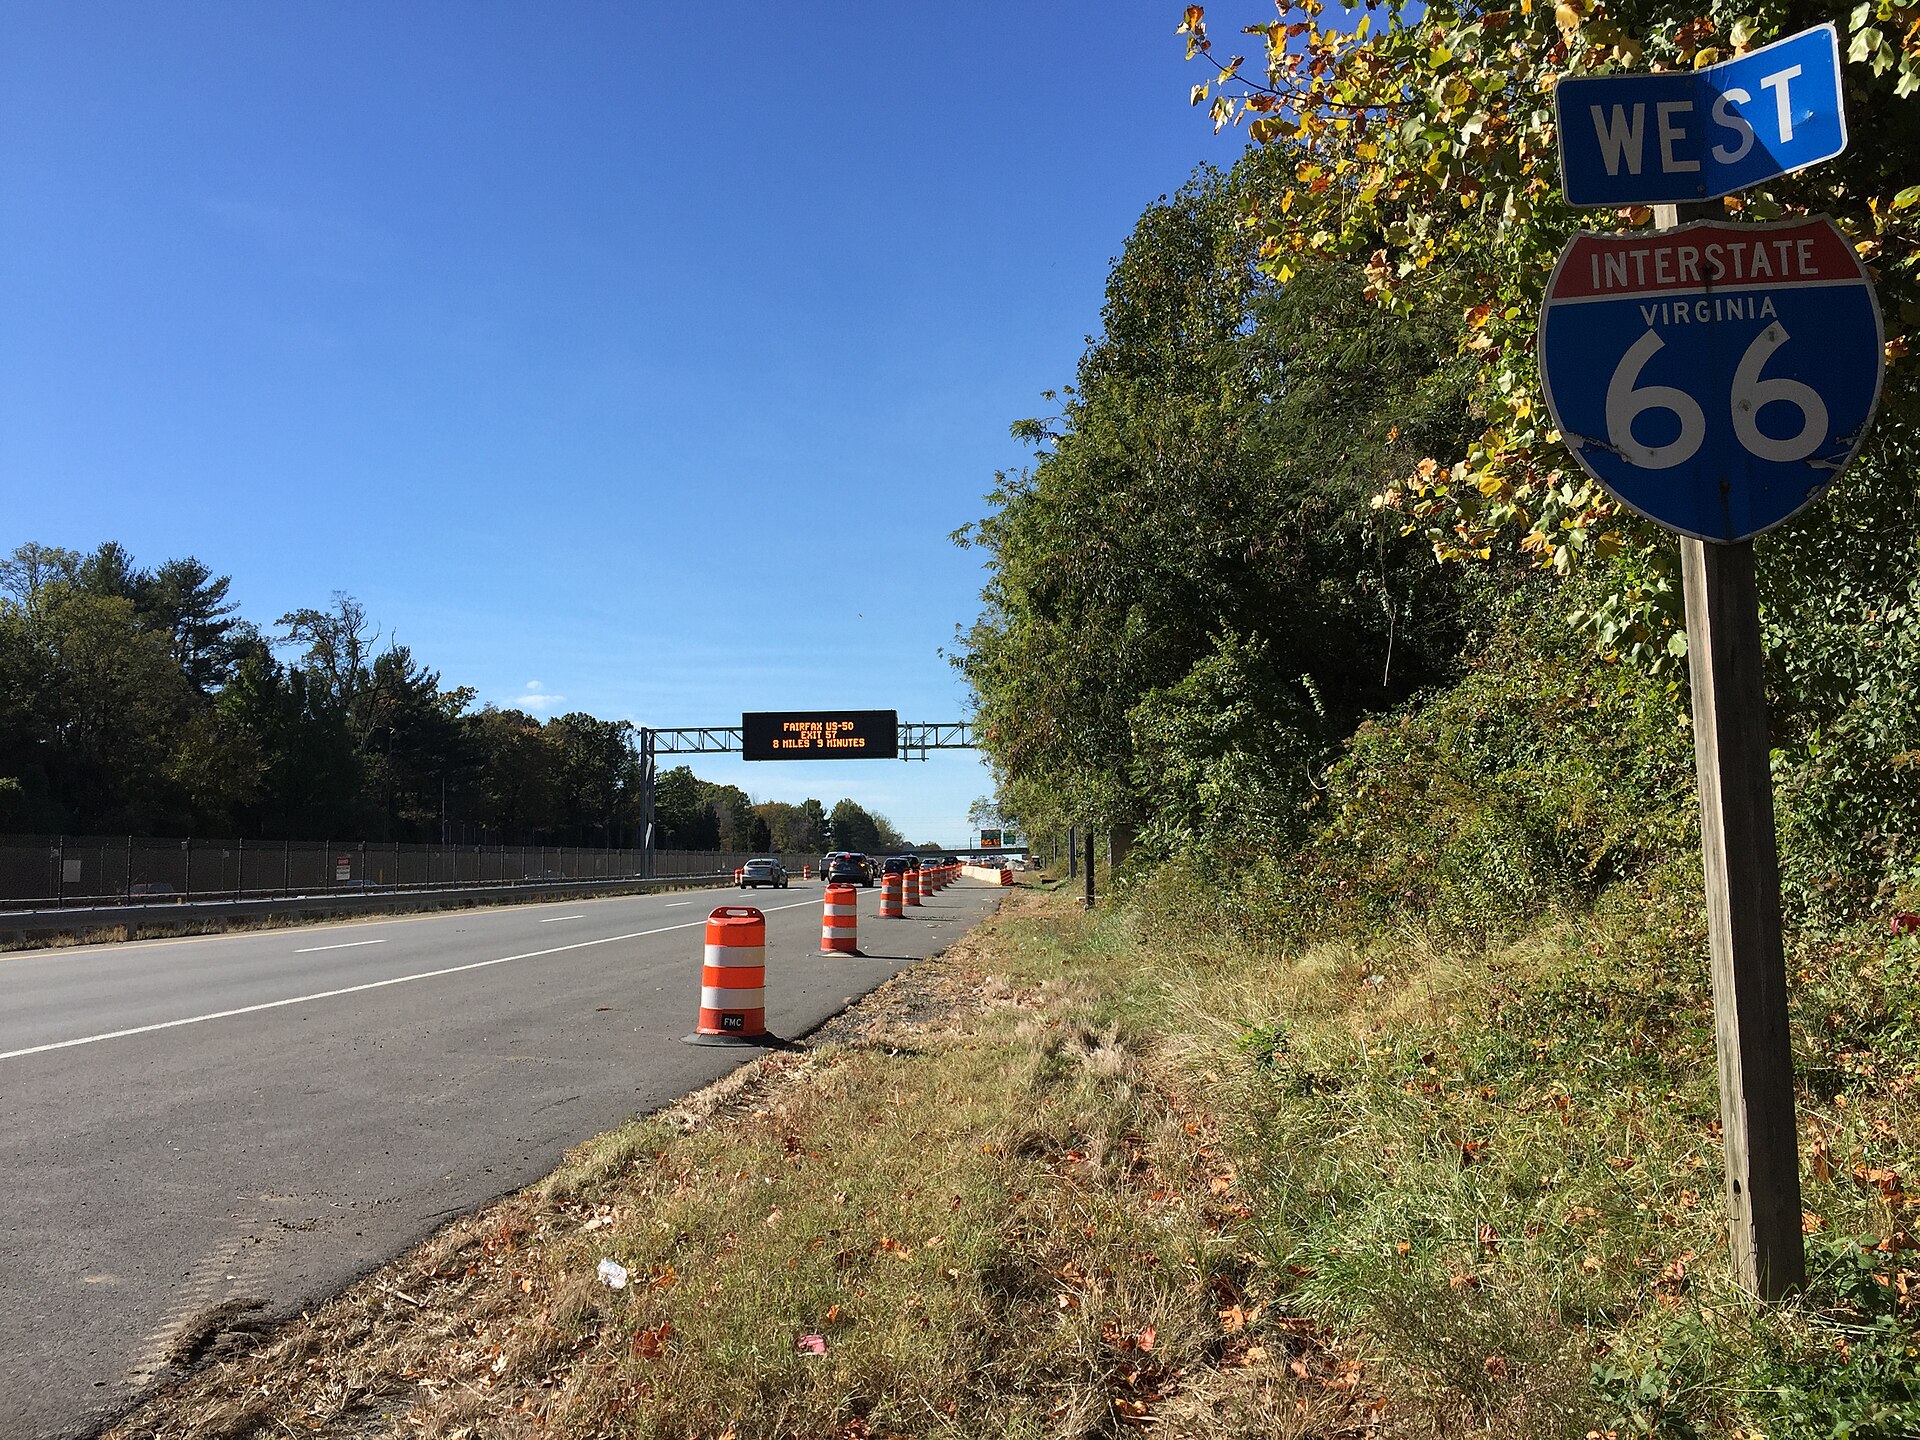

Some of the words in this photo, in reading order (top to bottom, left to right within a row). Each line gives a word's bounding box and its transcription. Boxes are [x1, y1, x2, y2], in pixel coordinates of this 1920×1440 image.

[1590, 64, 1802, 176] WEST
[1591, 238, 1819, 290] INTERSTATE
[1640, 296, 1777, 326] VIRGINIA
[1605, 320, 1829, 470] 66
[783, 722, 822, 731] FAIRFAX
[826, 722, 854, 730] US-50
[801, 731, 822, 739] EXIT
[825, 731, 837, 739] 57
[772, 740, 779, 748] 8
[782, 740, 810, 748] MILES
[816, 739, 823, 748] 9
[827, 738, 865, 748] MINUTES
[724, 1017, 742, 1027] FMC
